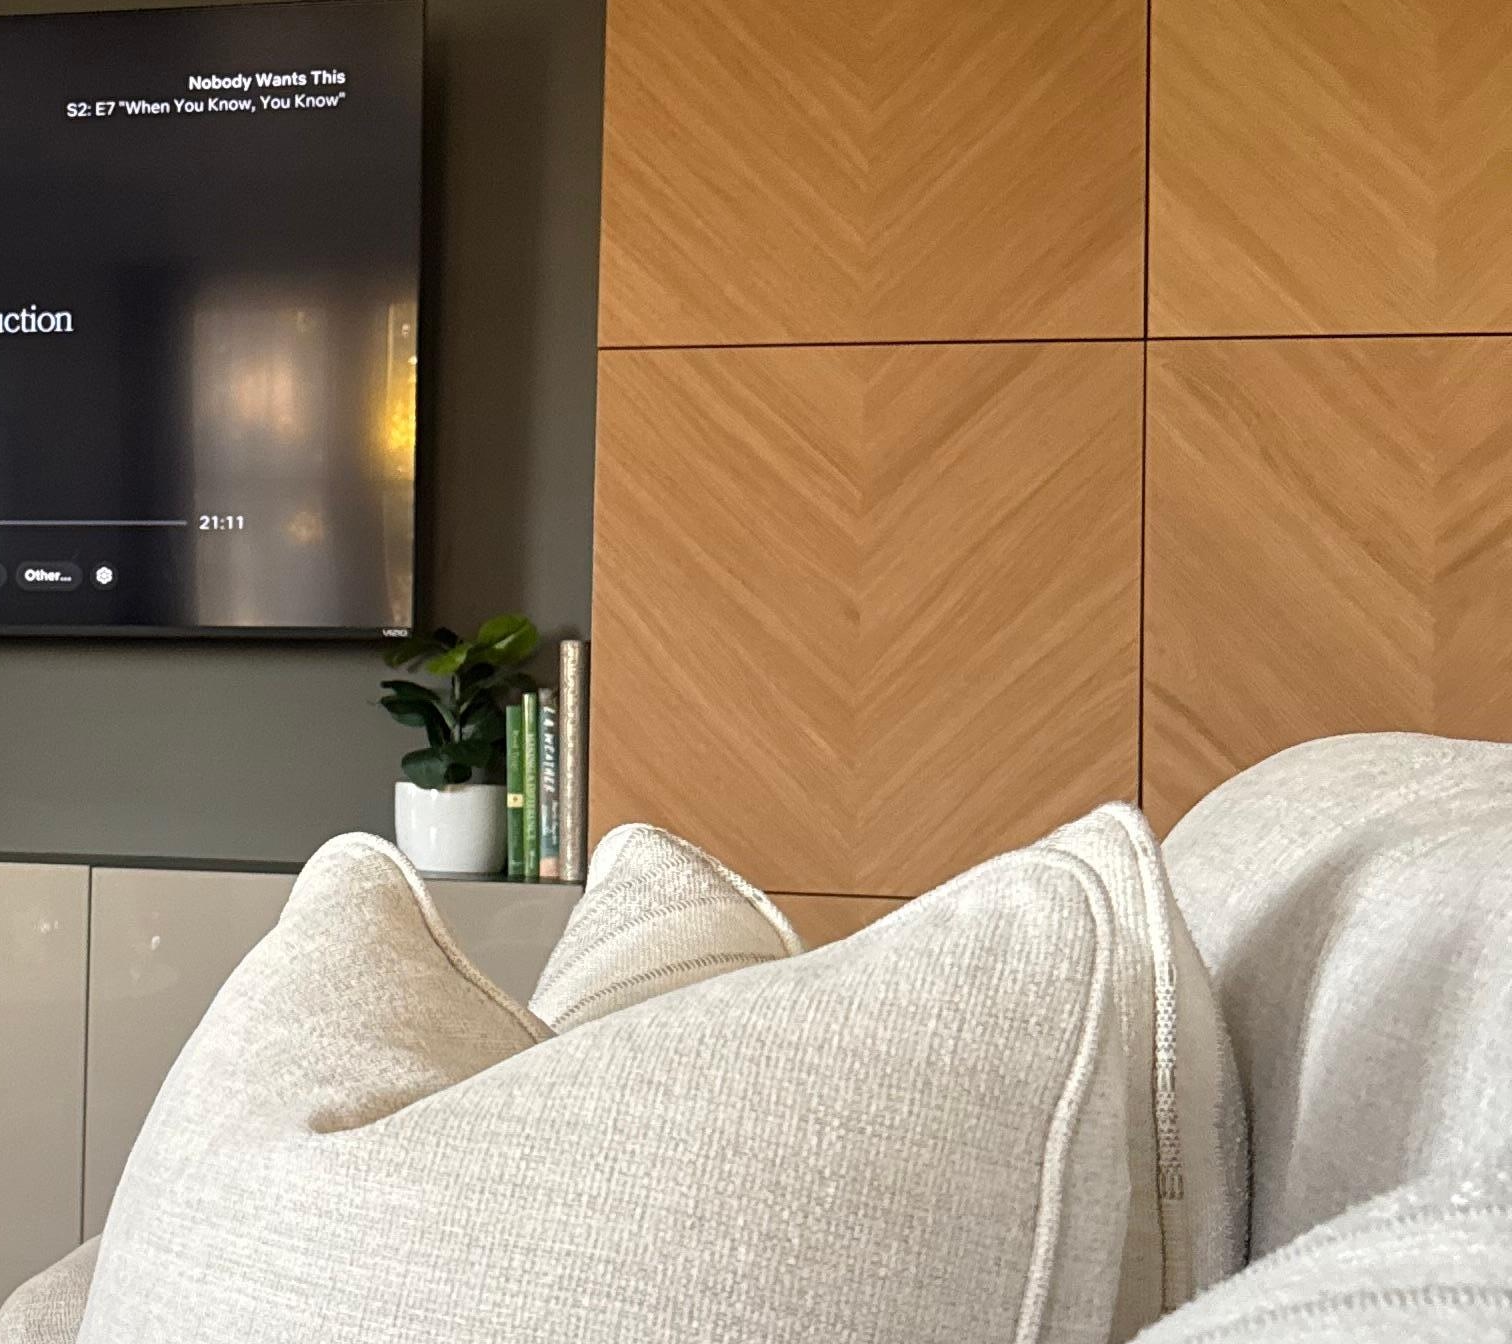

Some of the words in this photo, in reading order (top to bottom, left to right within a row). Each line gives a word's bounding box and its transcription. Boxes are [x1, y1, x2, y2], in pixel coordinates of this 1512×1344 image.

[188, 74, 252, 92] Nobody
[255, 72, 307, 87] Wants
[310, 69, 346, 85] This
[66, 102, 92, 117] S2:
[95, 101, 116, 116] E7
[118, 99, 170, 115] "When
[173, 98, 204, 113] You
[208, 97, 256, 113] Know,
[259, 95, 291, 109] You
[294, 91, 346, 108] Know"
[199, 515, 244, 530] 21:11
[24, 568, 72, 582] Other...
